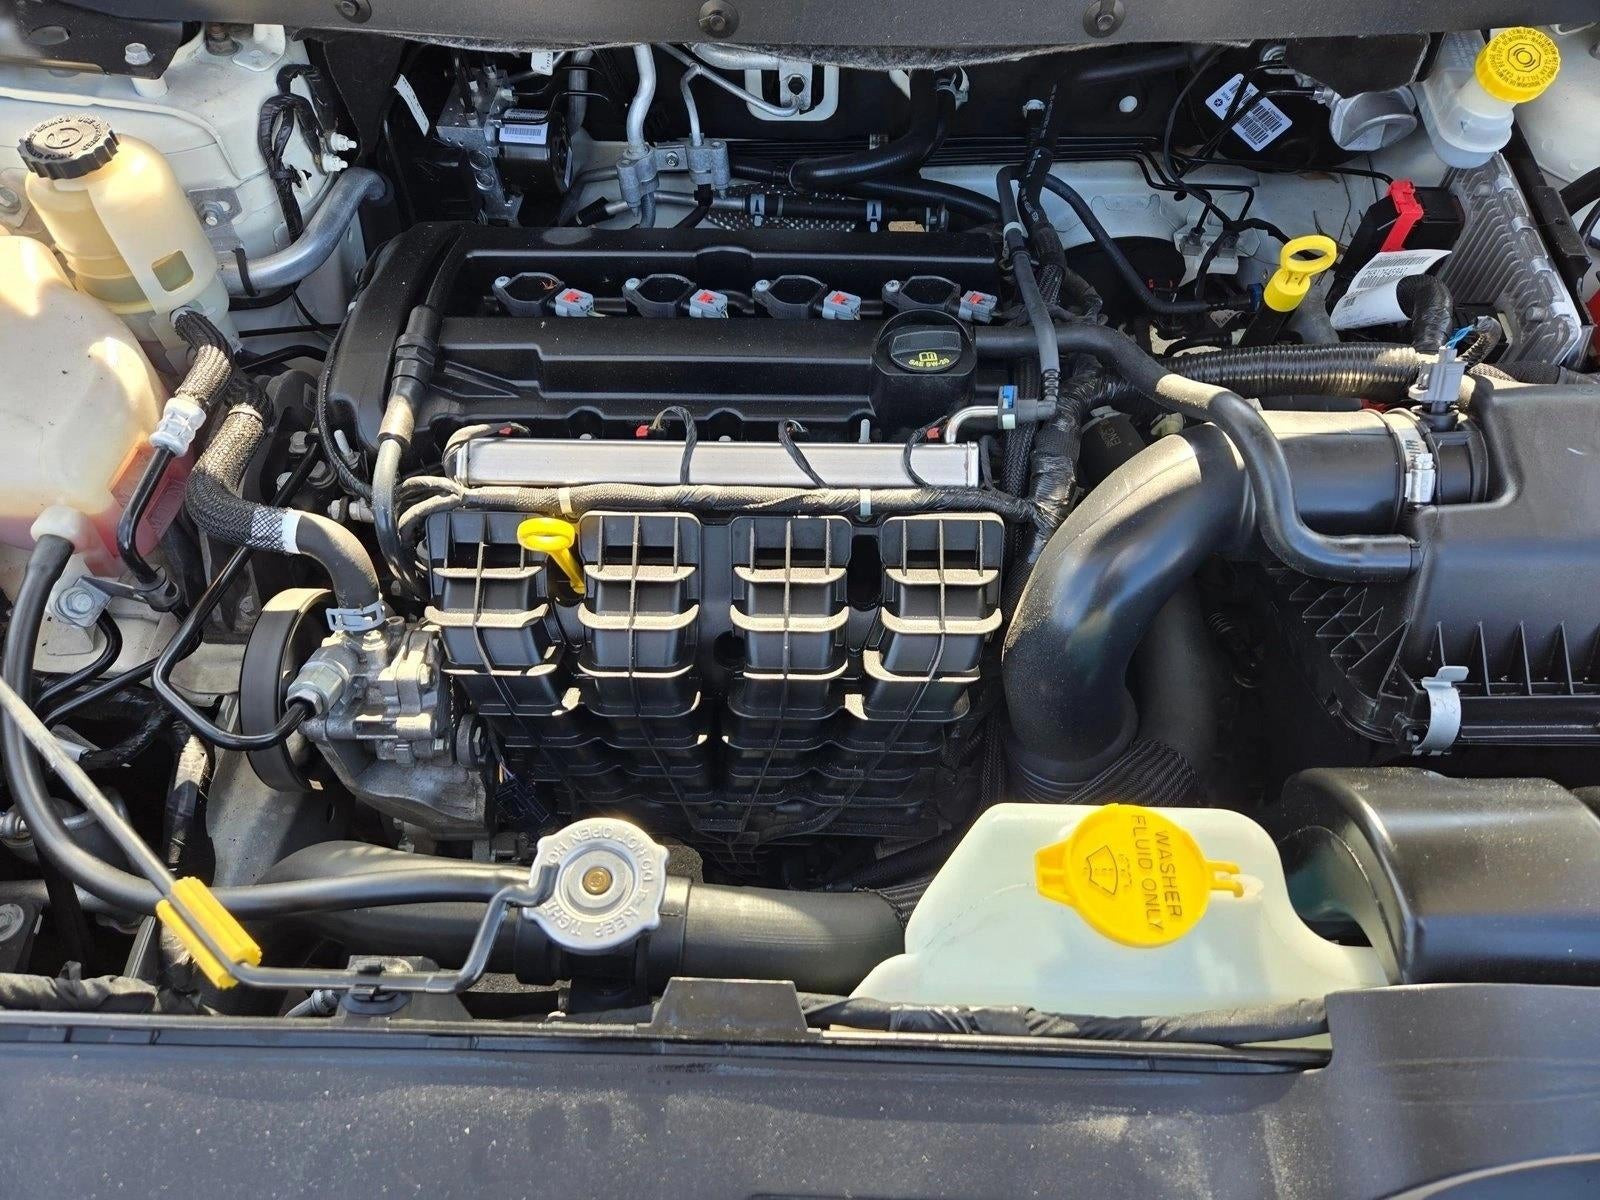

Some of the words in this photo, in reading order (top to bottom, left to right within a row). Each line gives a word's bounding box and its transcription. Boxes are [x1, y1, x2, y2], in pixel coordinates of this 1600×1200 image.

[908, 359, 924, 367] SAE
[569, 824, 614, 846] OPEN
[1131, 815, 1153, 870] FLUID
[1154, 830, 1182, 918] WASHER
[541, 901, 582, 937] TIGHT
[594, 905, 639, 938] KEEP
[1141, 878, 1164, 931] ONLY
